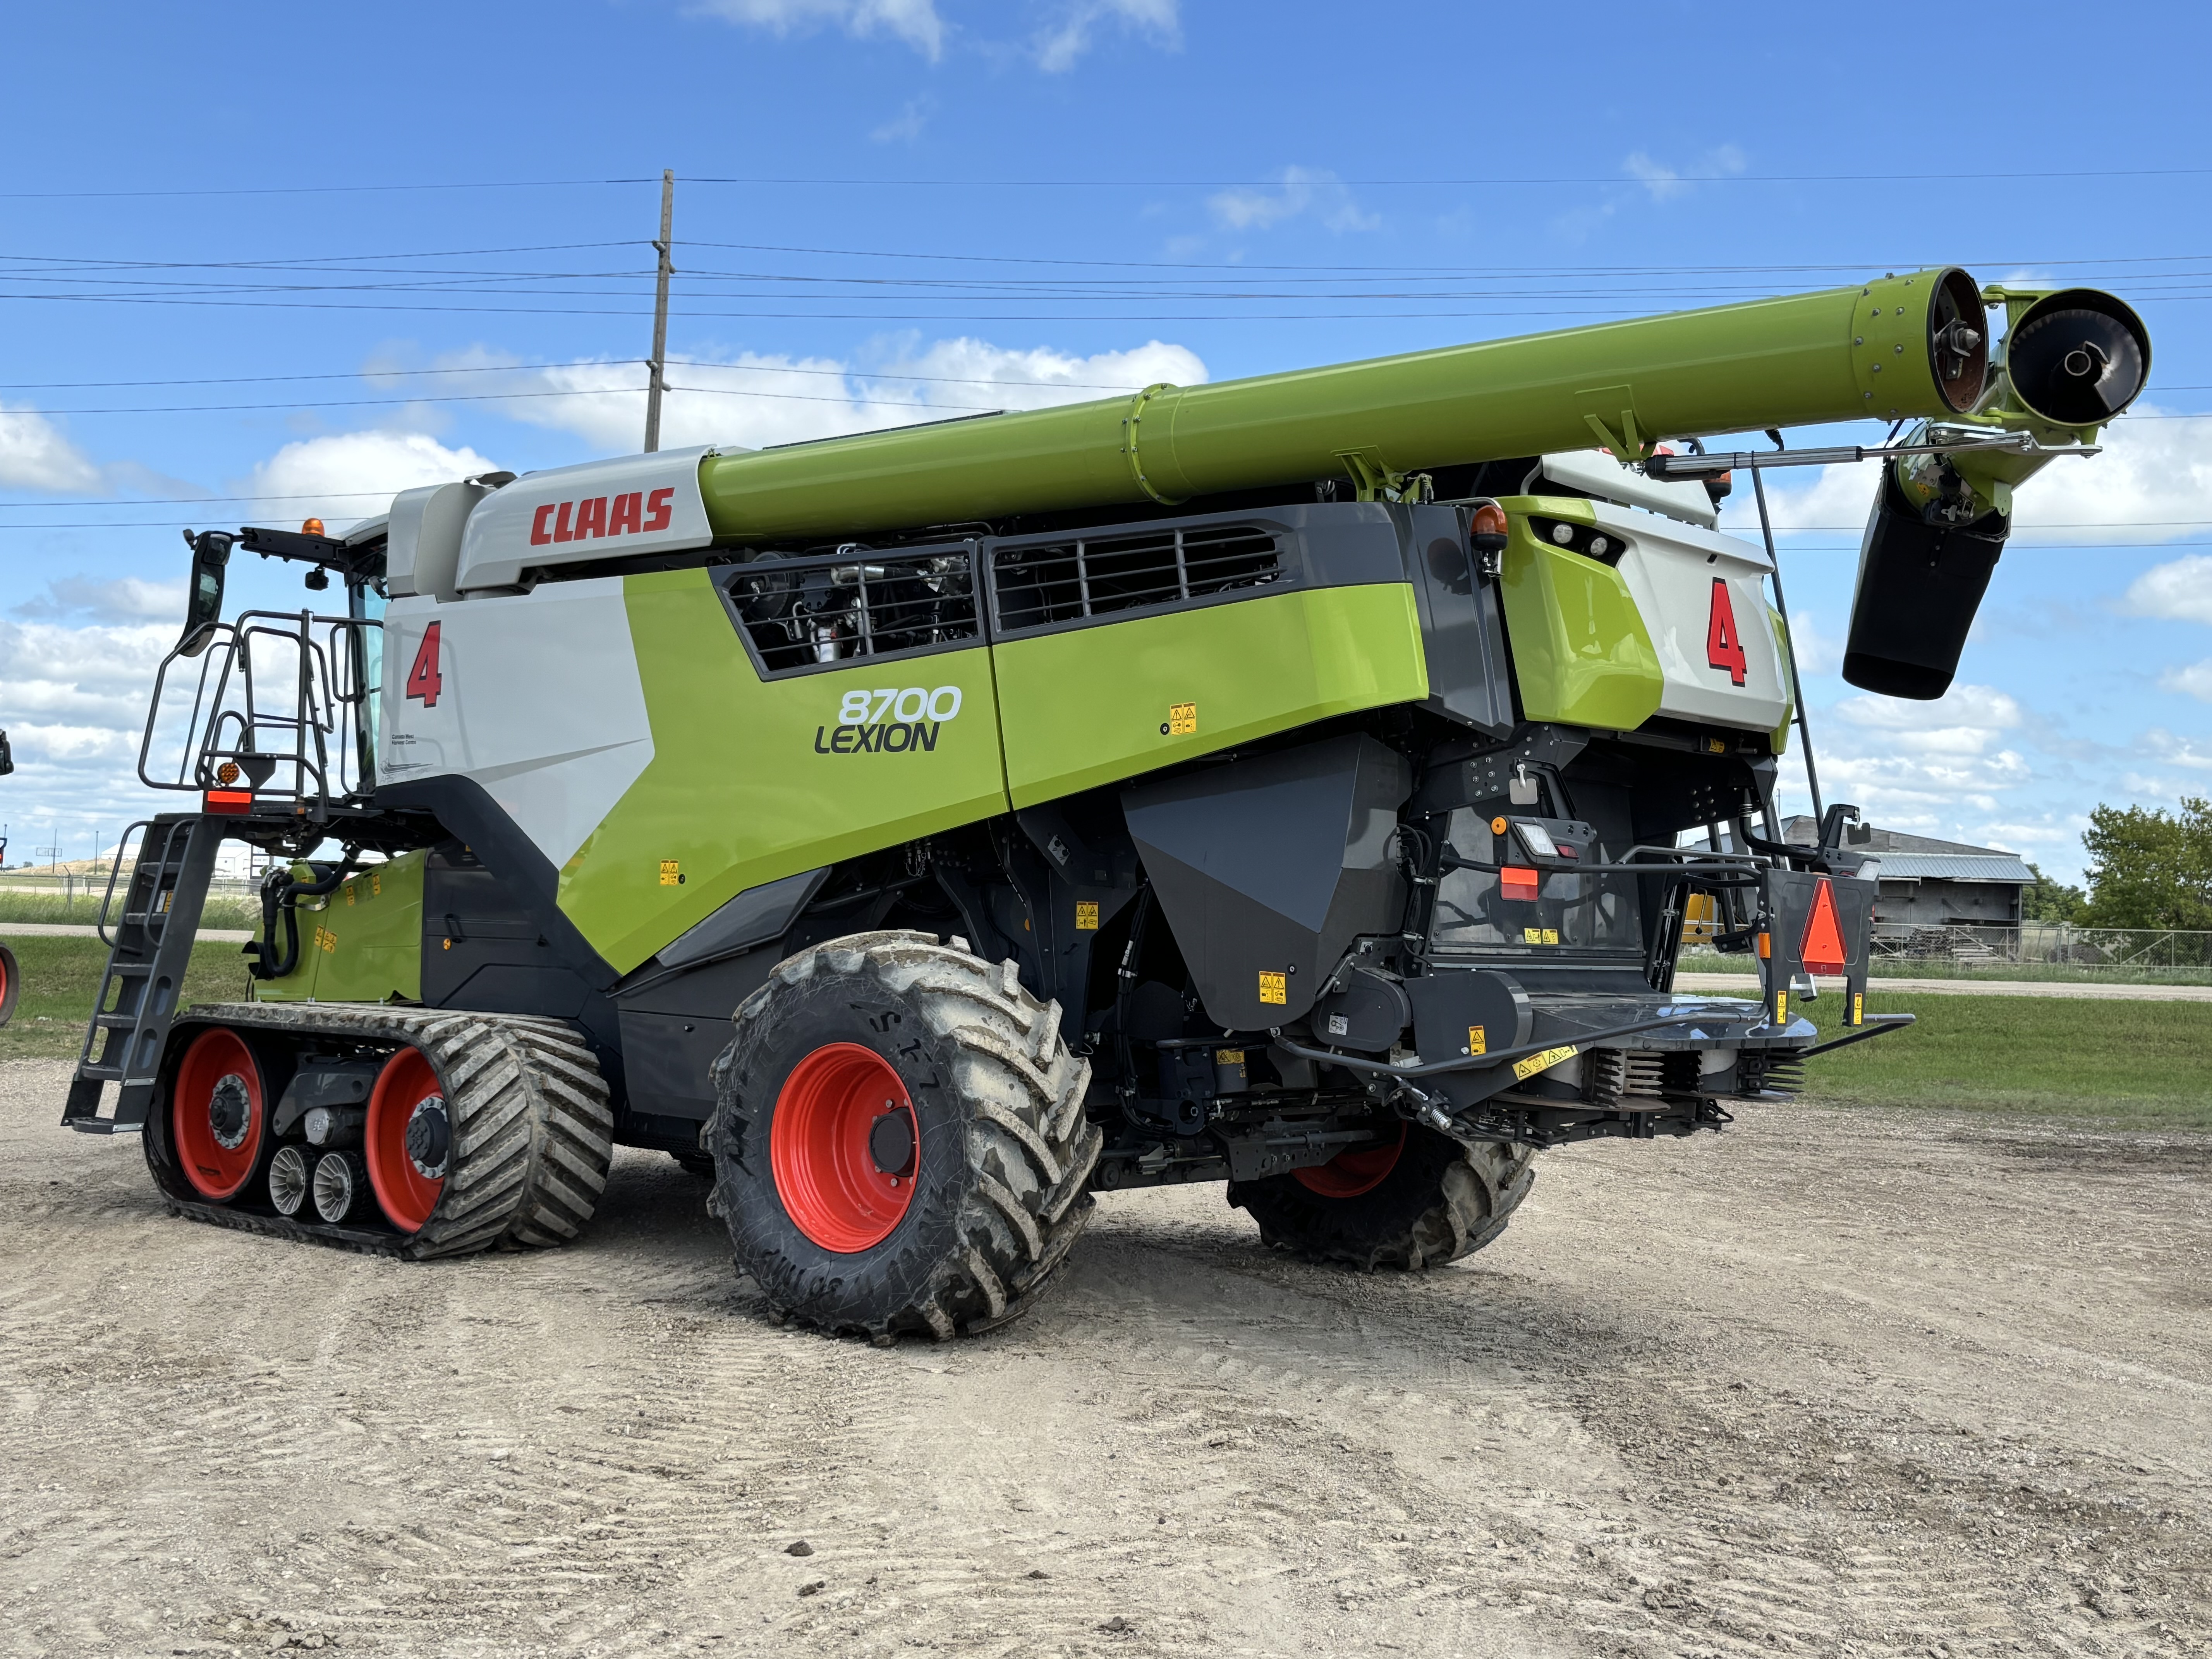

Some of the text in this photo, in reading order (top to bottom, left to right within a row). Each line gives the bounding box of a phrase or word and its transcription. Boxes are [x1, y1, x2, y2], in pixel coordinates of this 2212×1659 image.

[531, 487, 675, 546] CLAAS
[1707, 576, 1747, 688] 4
[406, 620, 442, 708] 4
[838, 685, 962, 725] 8700
[814, 722, 940, 754] LEXION
